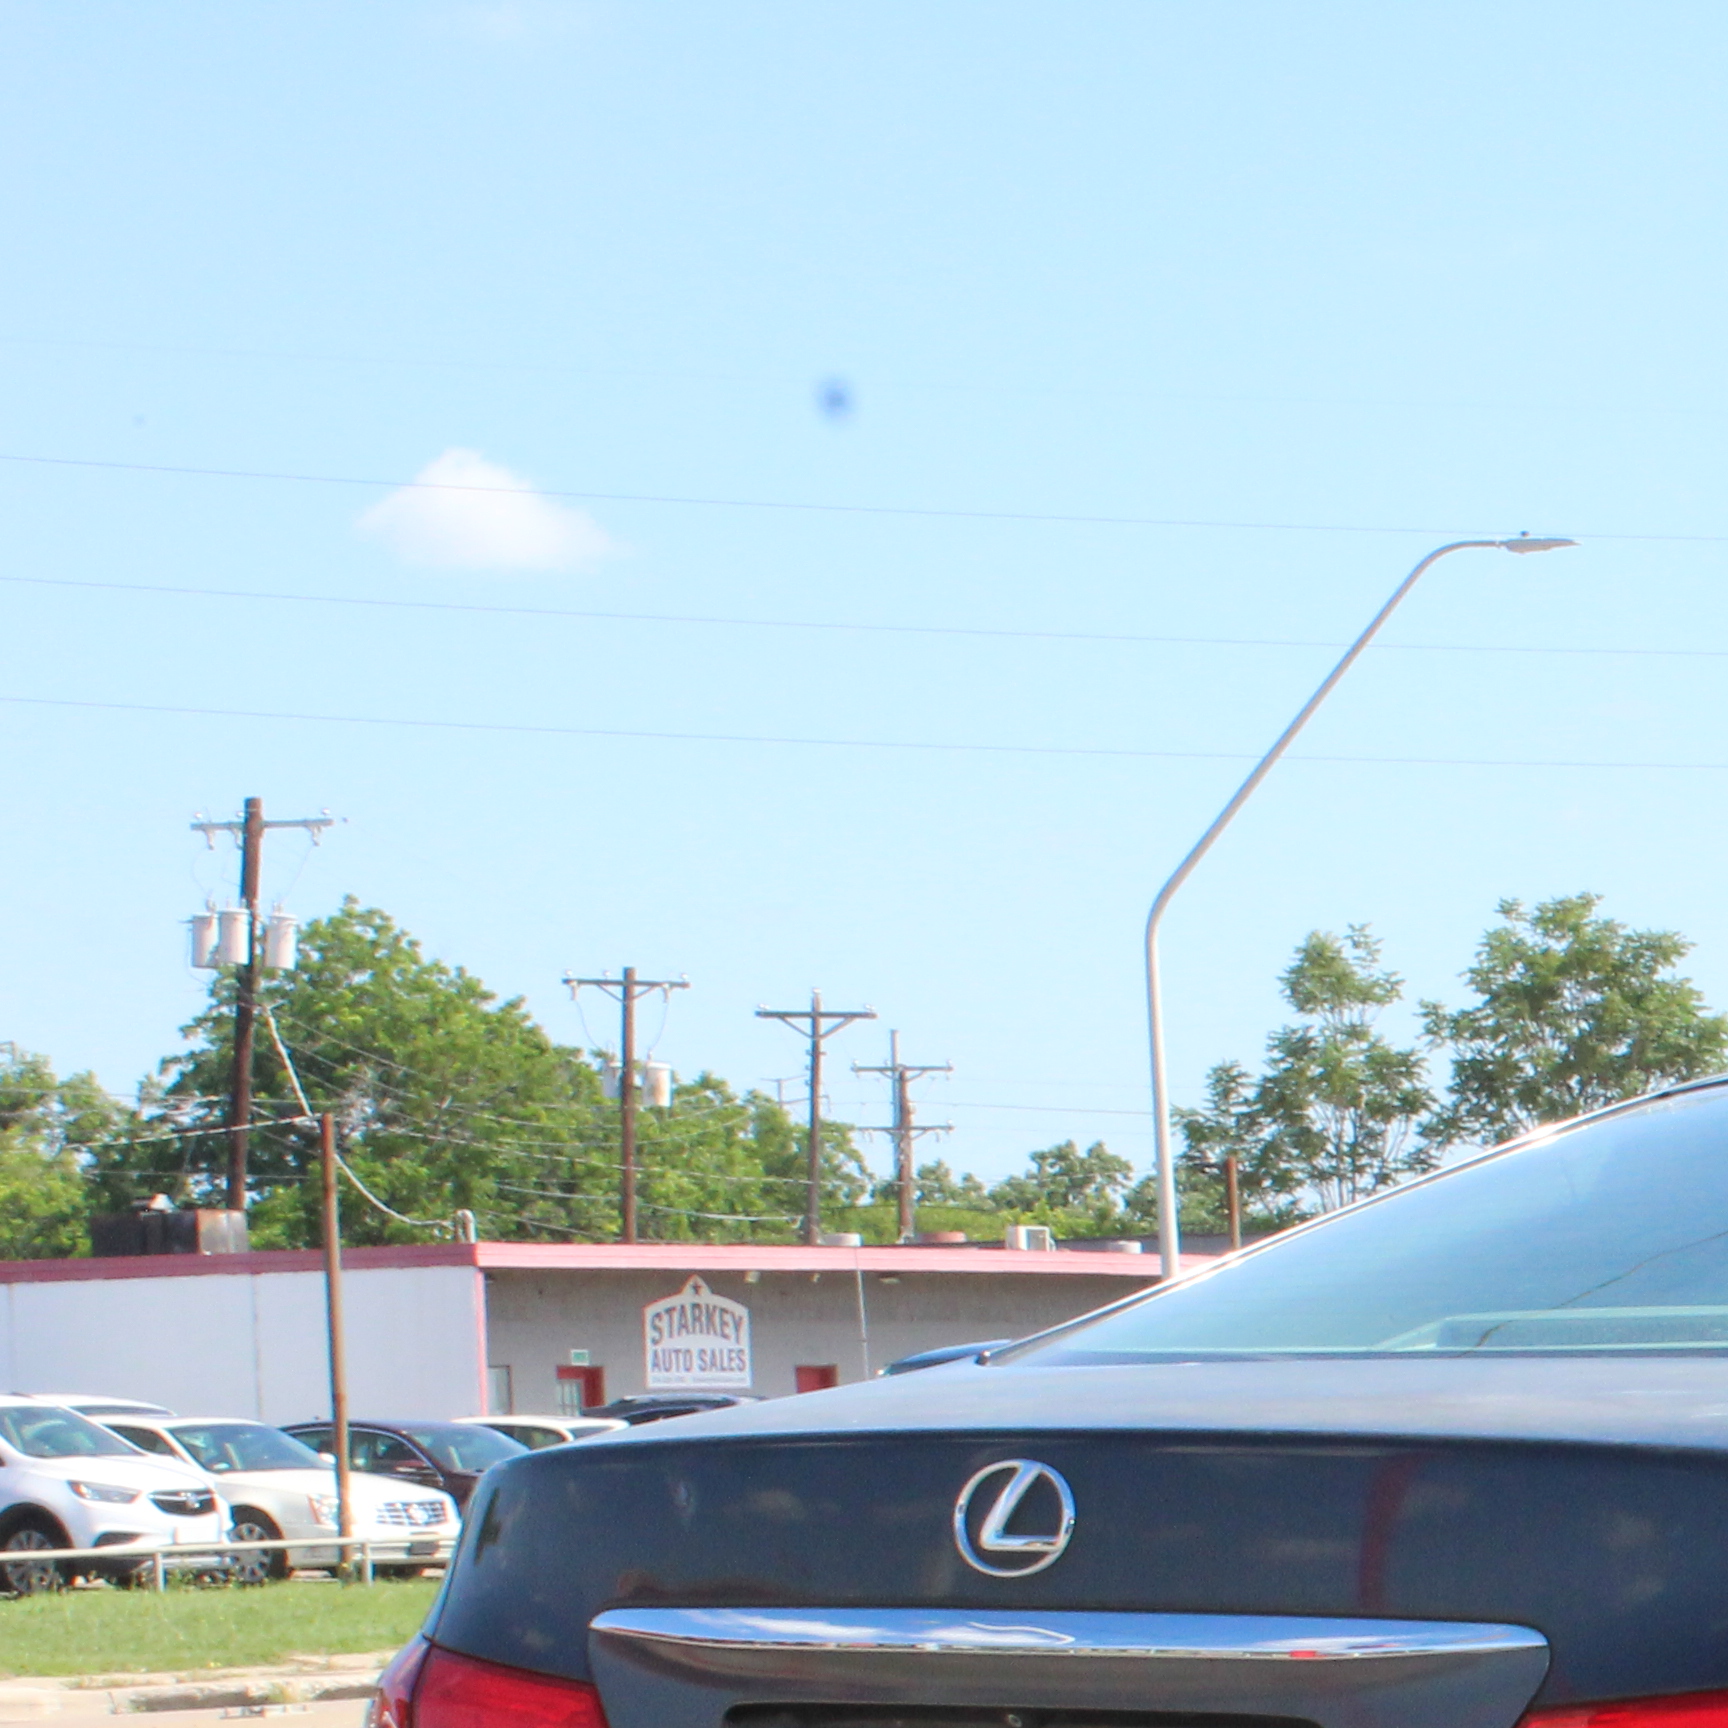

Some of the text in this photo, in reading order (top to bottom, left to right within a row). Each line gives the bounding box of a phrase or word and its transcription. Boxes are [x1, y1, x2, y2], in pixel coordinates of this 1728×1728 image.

[651, 1302, 743, 1346] STARKEY
[651, 1348, 746, 1373] AUTO SALES
